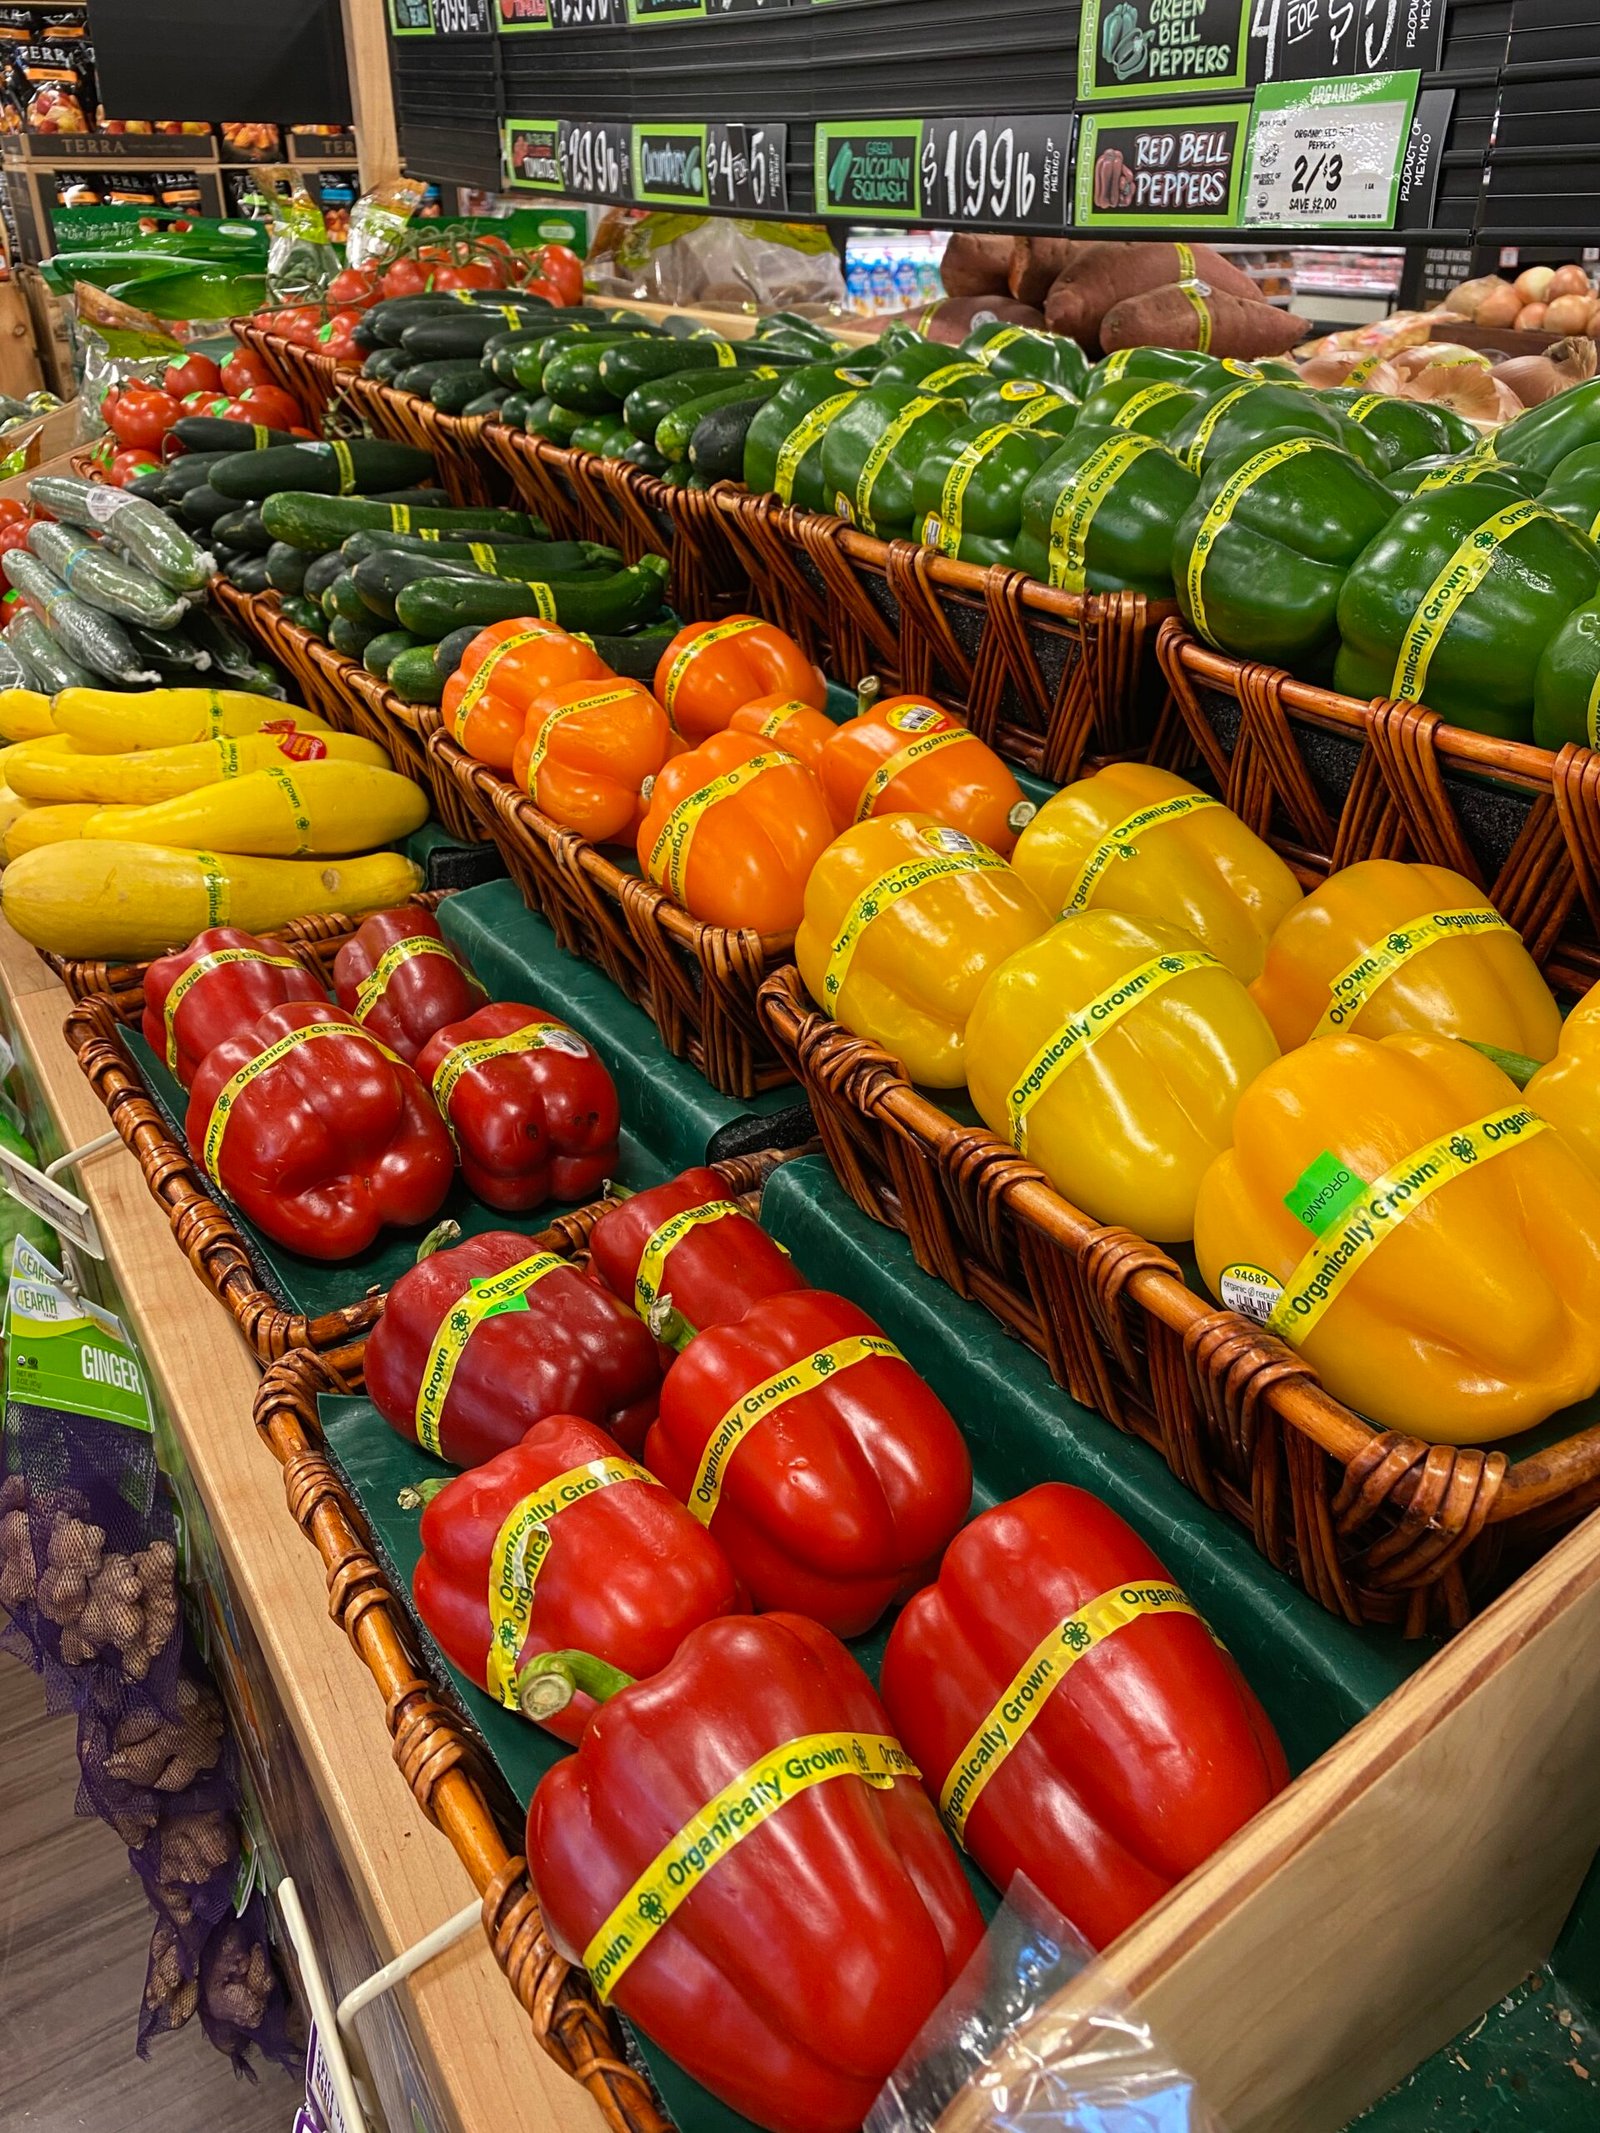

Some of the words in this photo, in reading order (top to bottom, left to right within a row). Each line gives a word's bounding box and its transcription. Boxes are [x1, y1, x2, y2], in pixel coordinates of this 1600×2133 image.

[1149, 0, 1207, 24] GREEN
[1159, 19, 1202, 46] BELL
[1287, 2, 1319, 37] FOR
[1419, 0, 1432, 29] MEX
[1082, 2, 1096, 97] RGANIC
[1149, 45, 1232, 78] PEPPERS
[61, 139, 127, 154] TERRA
[322, 140, 356, 155] TER
[751, 131, 765, 204] 5
[1135, 133, 1175, 169] RED
[1177, 130, 1231, 167] BELL
[1400, 140, 1419, 203] PRODUCT
[1411, 117, 1423, 136] OF
[1413, 133, 1432, 186] MEXICO
[851, 156, 911, 181] ZUCCHINI
[1043, 156, 1051, 204] PRODUCT
[1050, 150, 1061, 192] MEXICO
[1134, 169, 1228, 208] PEPPERS
[851, 179, 909, 203] SQUASH
[1289, 198, 1310, 211] SAVE
[1312, 197, 1337, 210] $2.00
[1118, 386, 1179, 428] rganically
[866, 433, 893, 471] Grown
[1088, 454, 1126, 493] Grown
[1212, 447, 1283, 518] Organically
[1189, 568, 1203, 621] Grown
[1423, 564, 1470, 622] Grown
[576, 693, 620, 710] Grown
[762, 717, 782, 739] own
[228, 741, 239, 773] Grown
[281, 776, 301, 810] Grown
[1113, 798, 1194, 839] Organically
[650, 823, 674, 865] Grown
[888, 856, 977, 895] Organically
[1334, 955, 1379, 998] rown
[235, 1030, 308, 1085] Organically
[310, 1024, 359, 1035] Grown
[1012, 1015, 1093, 1105] Organically
[1090, 973, 1150, 1021] Grown
[206, 1123, 219, 1167] Grown
[1302, 1170, 1349, 1224] ORGANIC
[650, 1200, 723, 1252] Organically
[1290, 1216, 1376, 1316] Organically
[1368, 1161, 1440, 1221] Grown
[475, 1254, 563, 1300] Organically
[1223, 1279, 1248, 1295] organic
[1233, 1268, 1268, 1286] 94689
[81, 1344, 142, 1395] GINGER
[423, 1347, 449, 1404] Grown
[696, 1409, 745, 1505] Organically
[742, 1373, 802, 1414] Grown
[498, 1498, 558, 1603] Organically
[513, 1530, 551, 1623] Organica
[943, 1720, 1009, 1829] Organically
[1001, 1657, 1055, 1725] Grown
[665, 1772, 784, 1887] Organically
[783, 1744, 849, 1781] Grown
